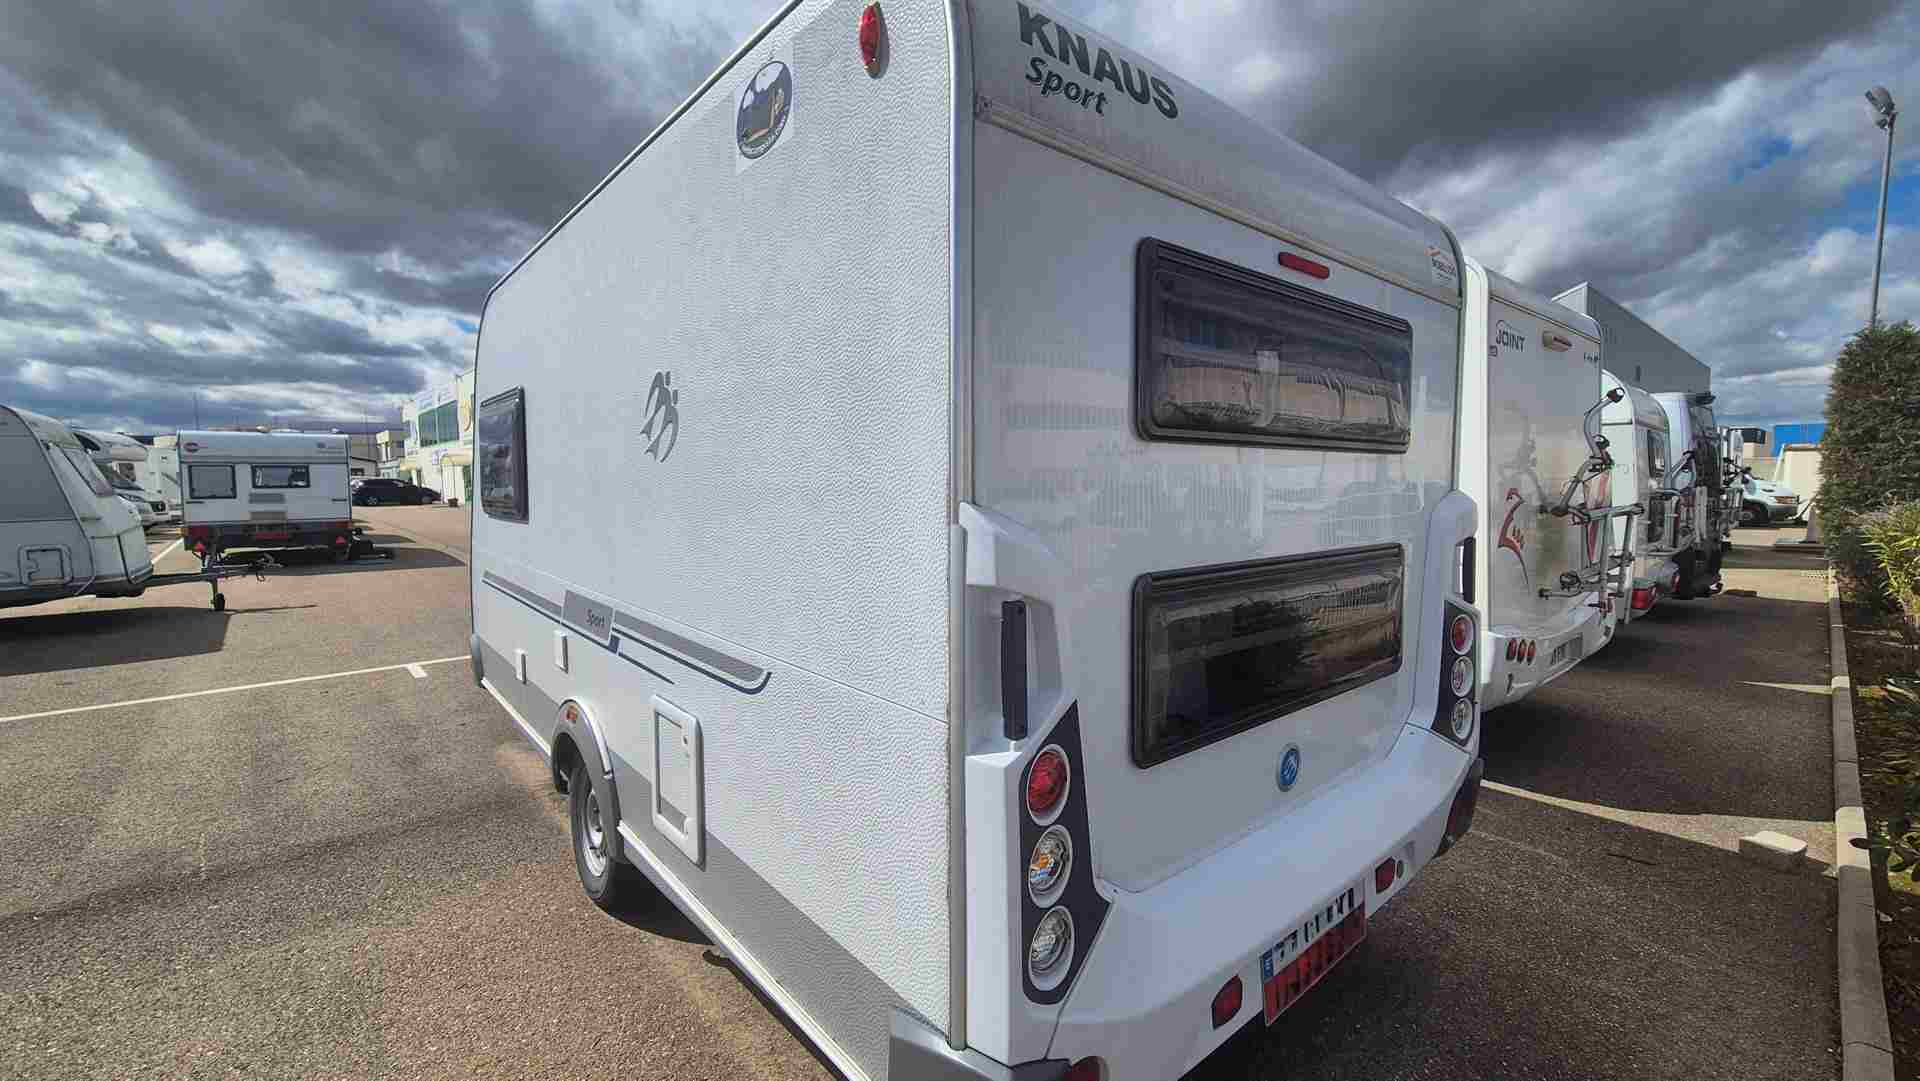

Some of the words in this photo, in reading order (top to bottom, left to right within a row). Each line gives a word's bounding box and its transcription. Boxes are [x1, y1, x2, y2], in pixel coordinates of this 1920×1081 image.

[1017, 1, 1179, 119] KNAUS
[1025, 56, 1108, 115] Sport
[1496, 329, 1526, 352] JOINT
